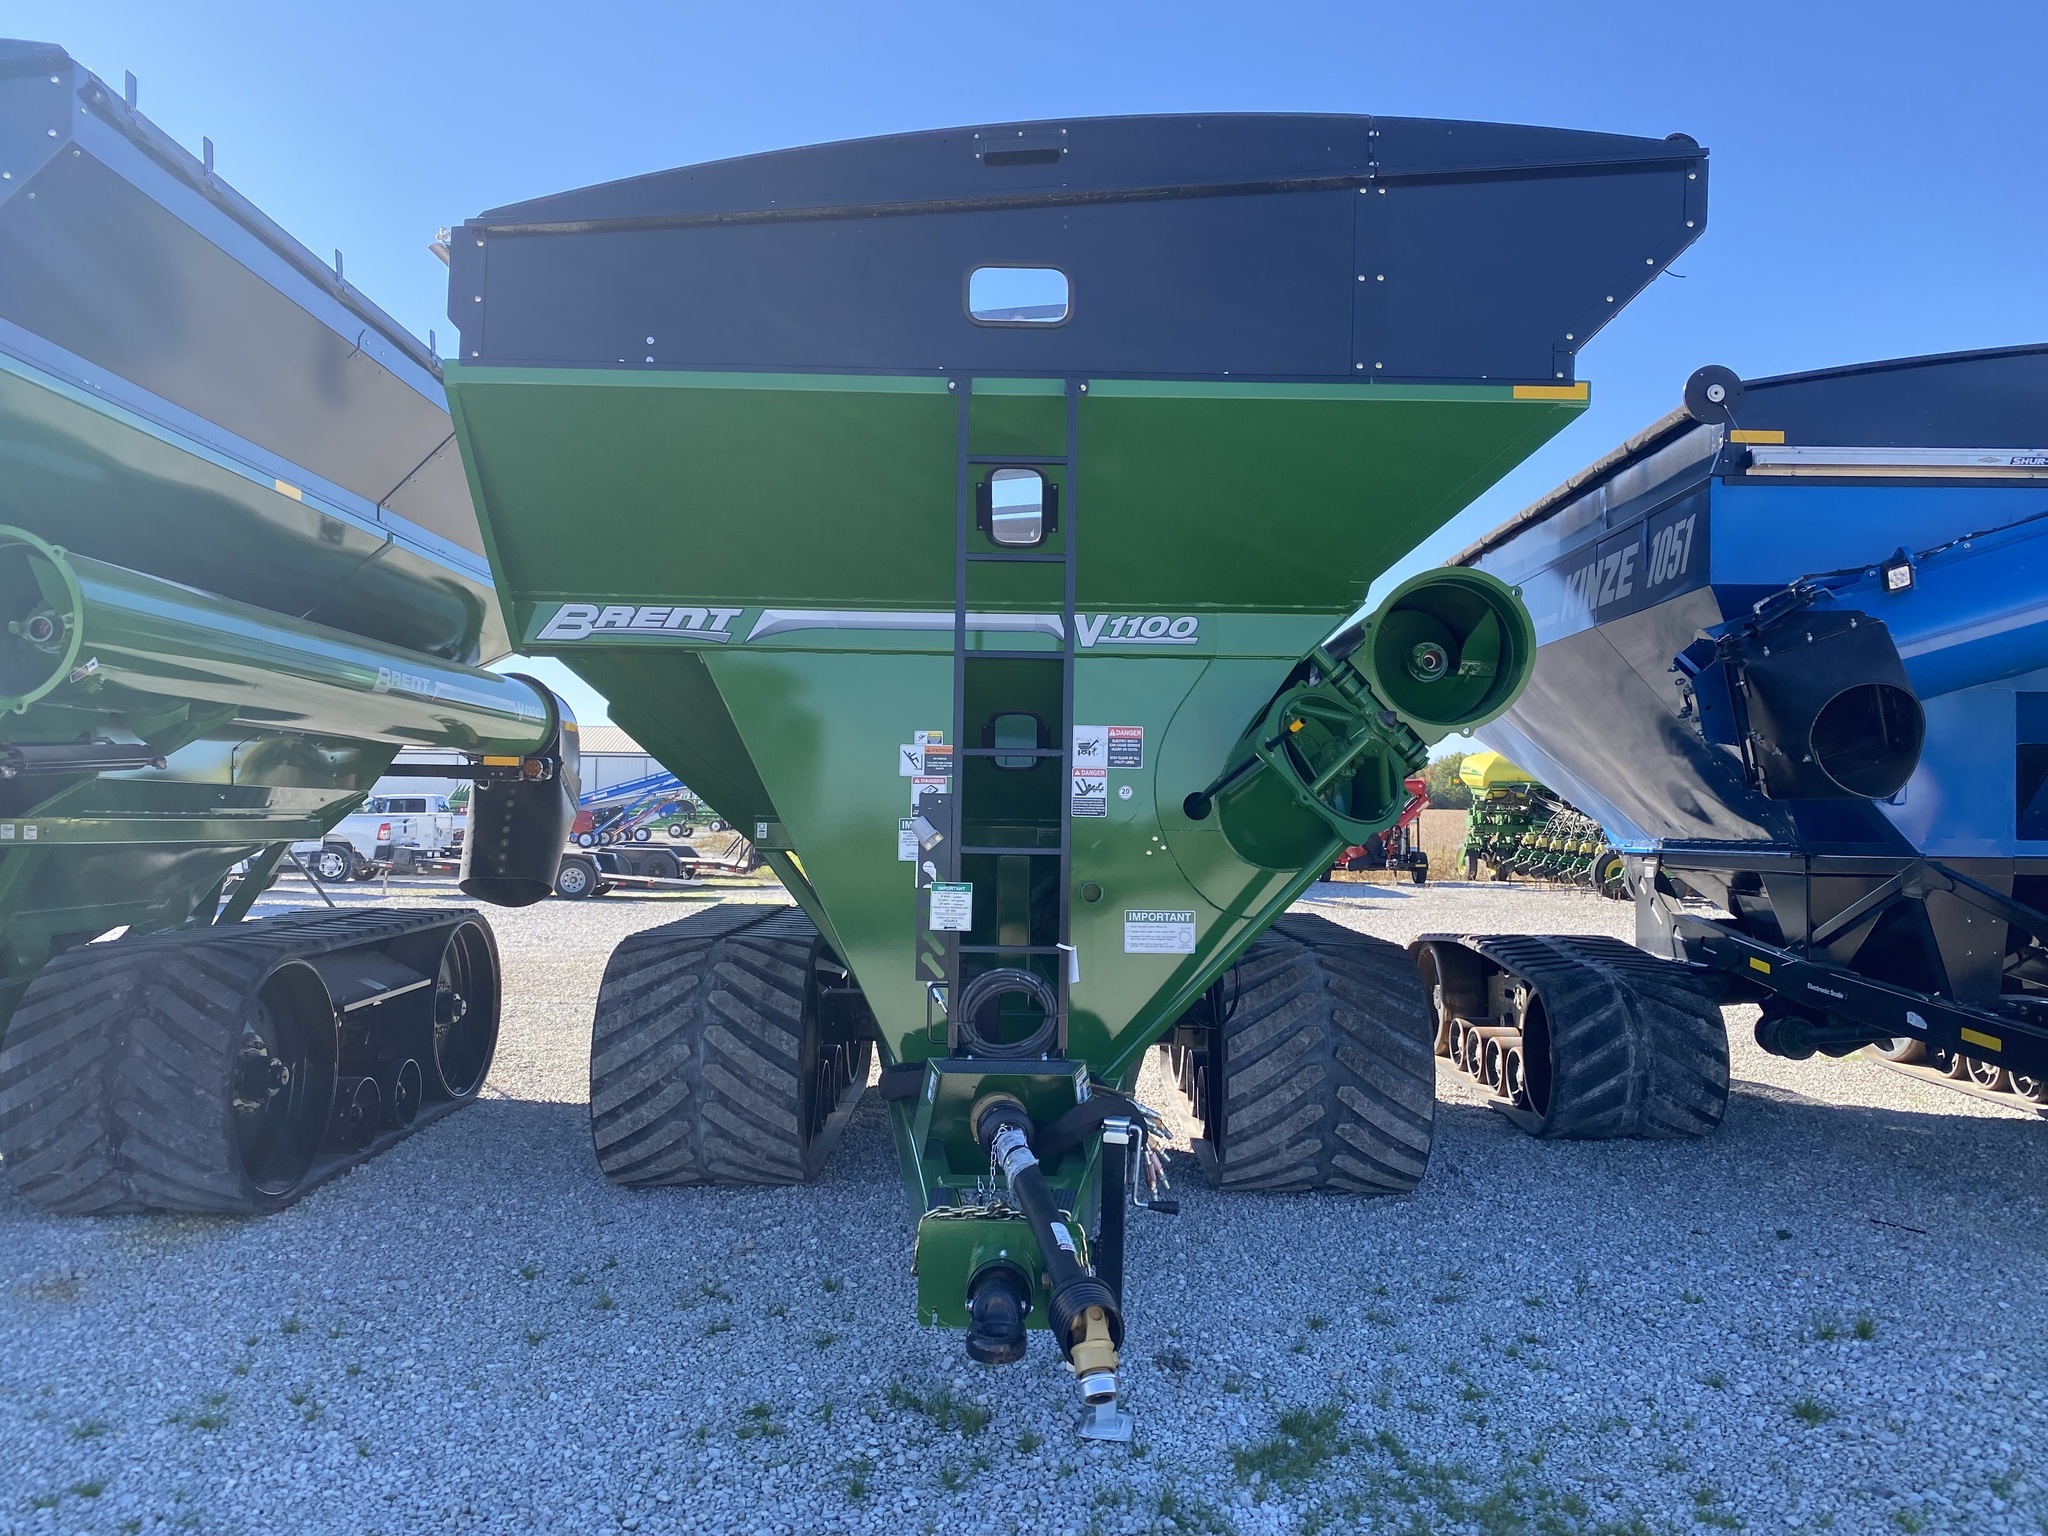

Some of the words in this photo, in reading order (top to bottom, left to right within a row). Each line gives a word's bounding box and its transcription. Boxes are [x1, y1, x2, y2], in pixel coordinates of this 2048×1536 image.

[1561, 541, 1640, 622] KINZE
[1646, 513, 1697, 589] 1051
[1073, 614, 1199, 648] V1100
[516, 701, 541, 721] V1100
[1116, 729, 1142, 737] DANGER
[1128, 912, 1192, 922] IMPORTANT
